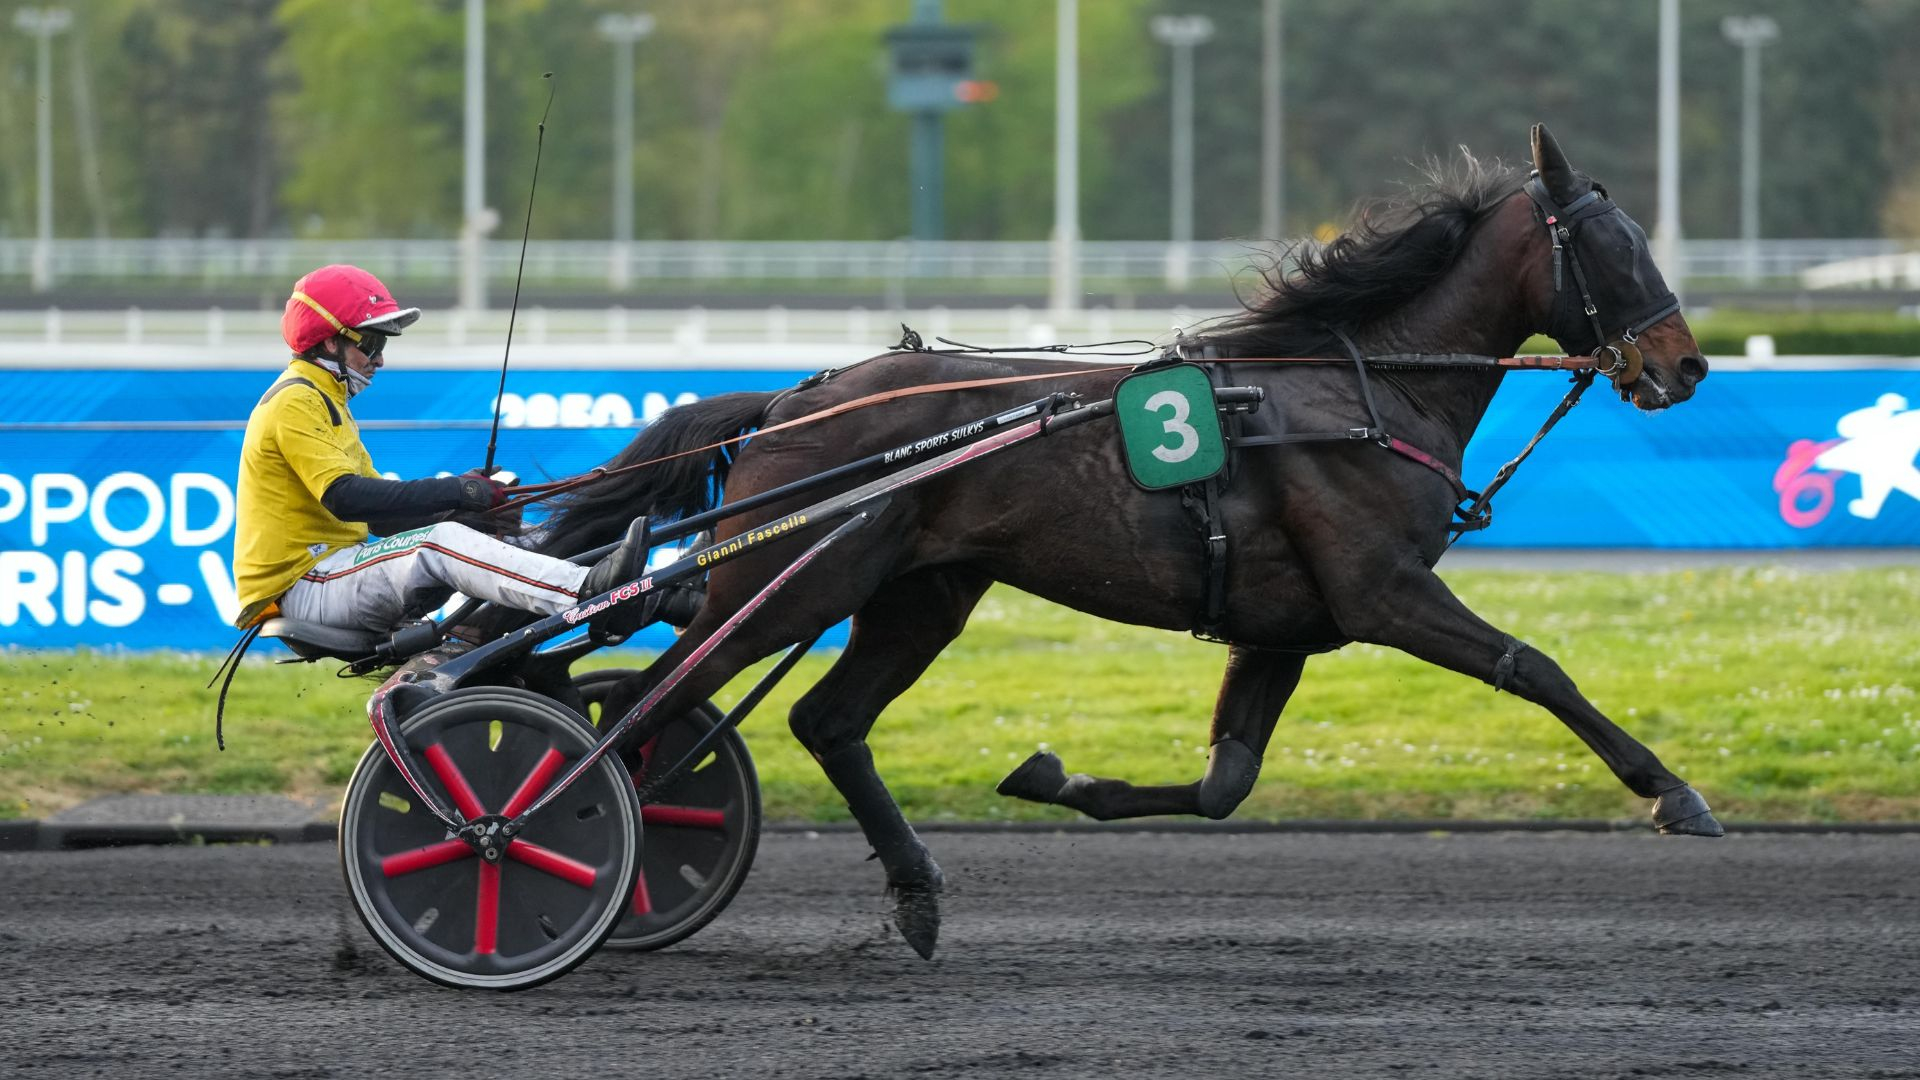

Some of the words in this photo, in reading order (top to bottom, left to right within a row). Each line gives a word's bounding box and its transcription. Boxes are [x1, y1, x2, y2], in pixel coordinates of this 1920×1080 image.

[884, 446, 912, 463] BLANC
[915, 432, 949, 453] SPORTS
[951, 421, 984, 441] SULKYS
[1144, 390, 1200, 463] 3
[697, 539, 743, 566] Gianni
[747, 514, 807, 545] Fascella
[610, 582, 639, 605] FCS
